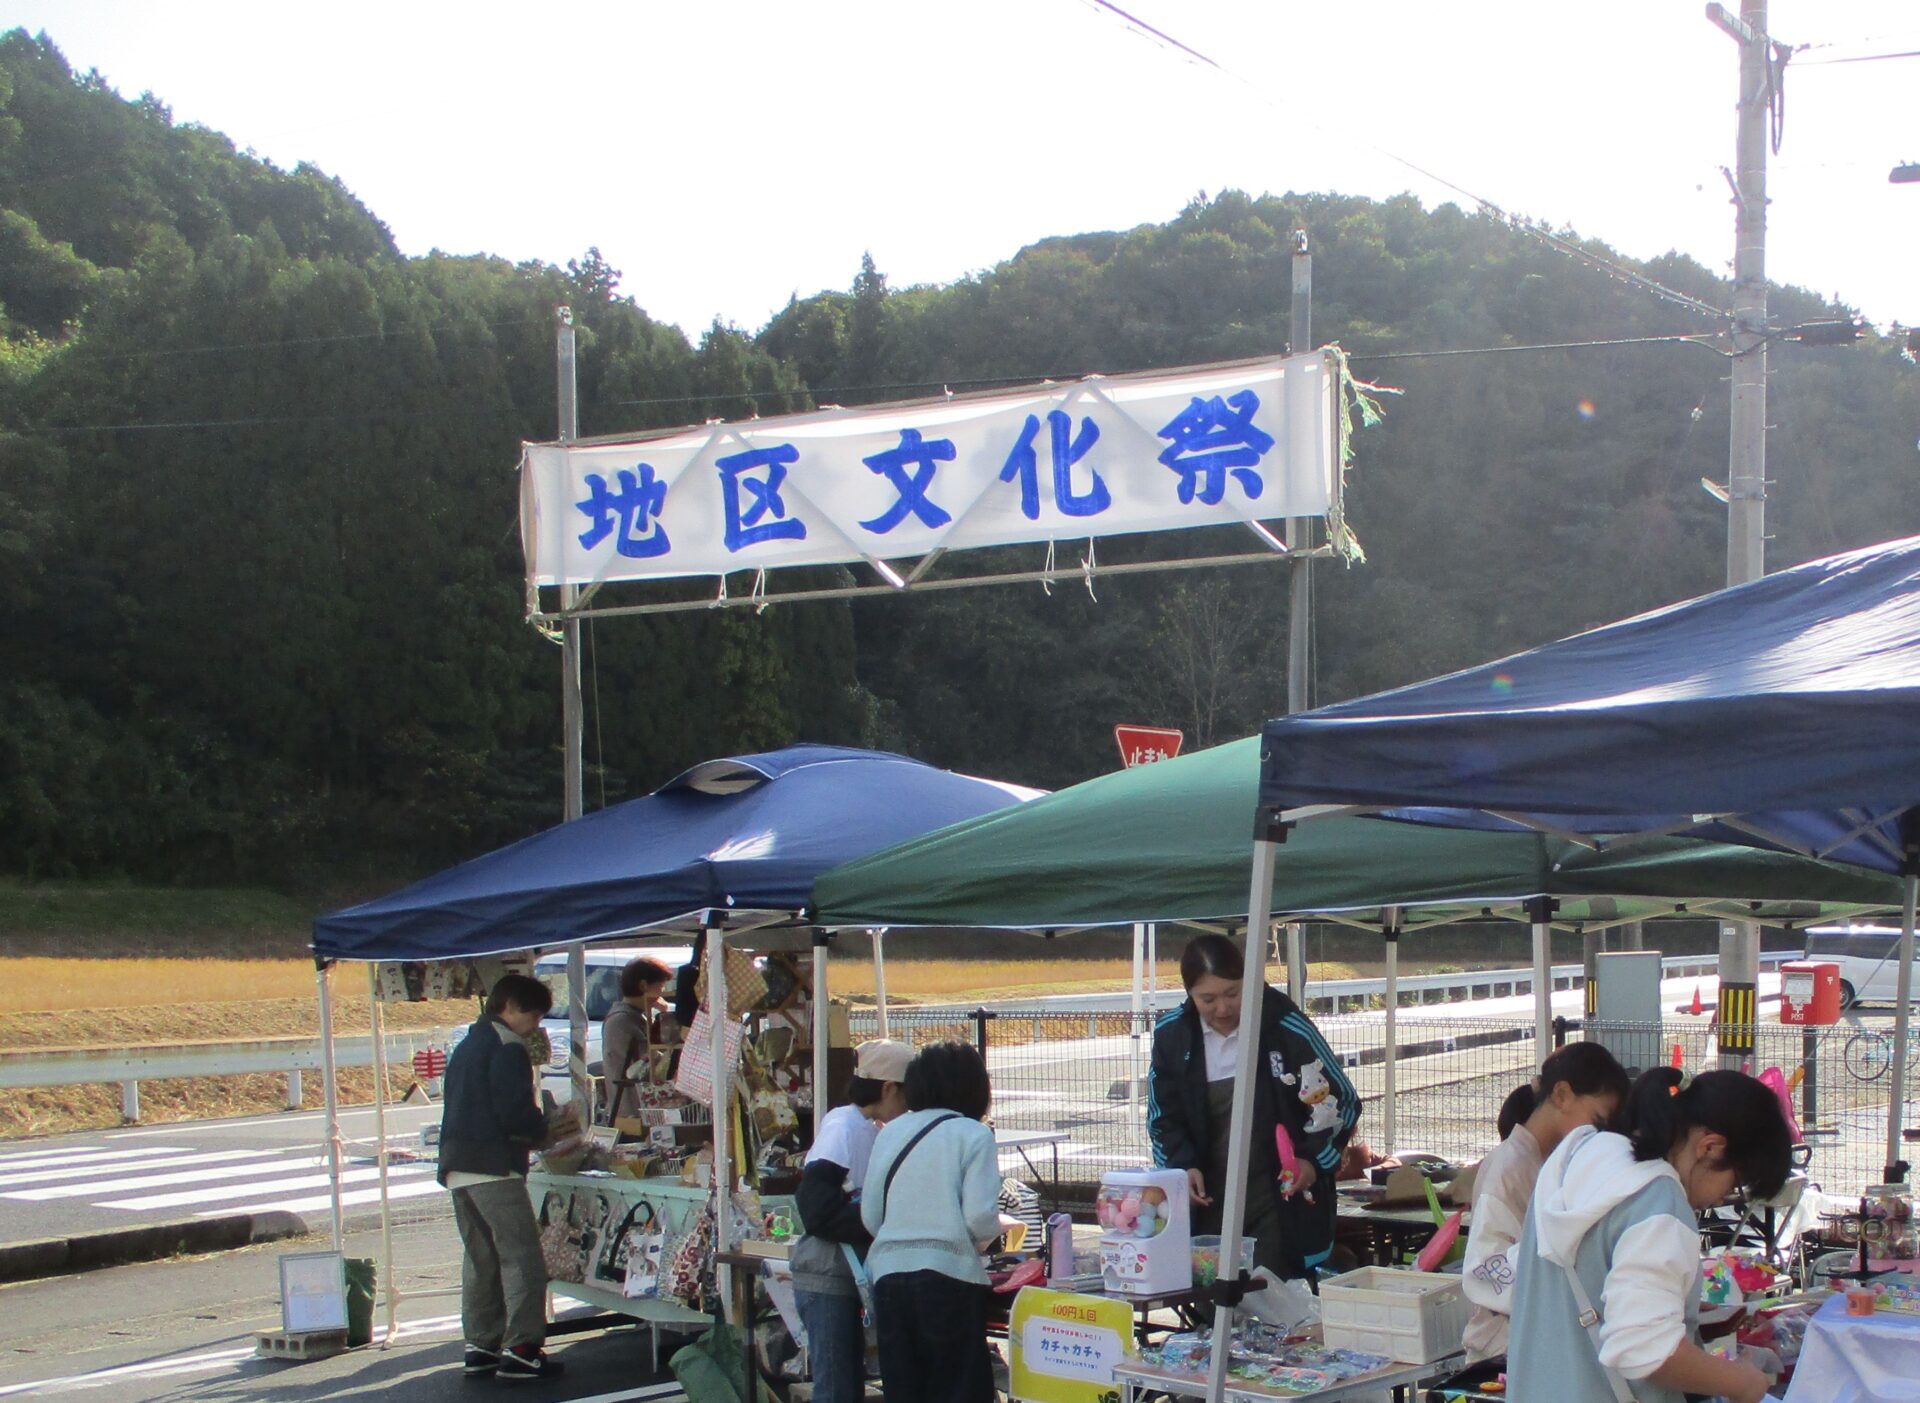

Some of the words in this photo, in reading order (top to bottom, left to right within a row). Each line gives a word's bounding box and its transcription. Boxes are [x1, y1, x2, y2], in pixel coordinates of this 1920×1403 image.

[575, 389, 1276, 560] 地区文化祭
